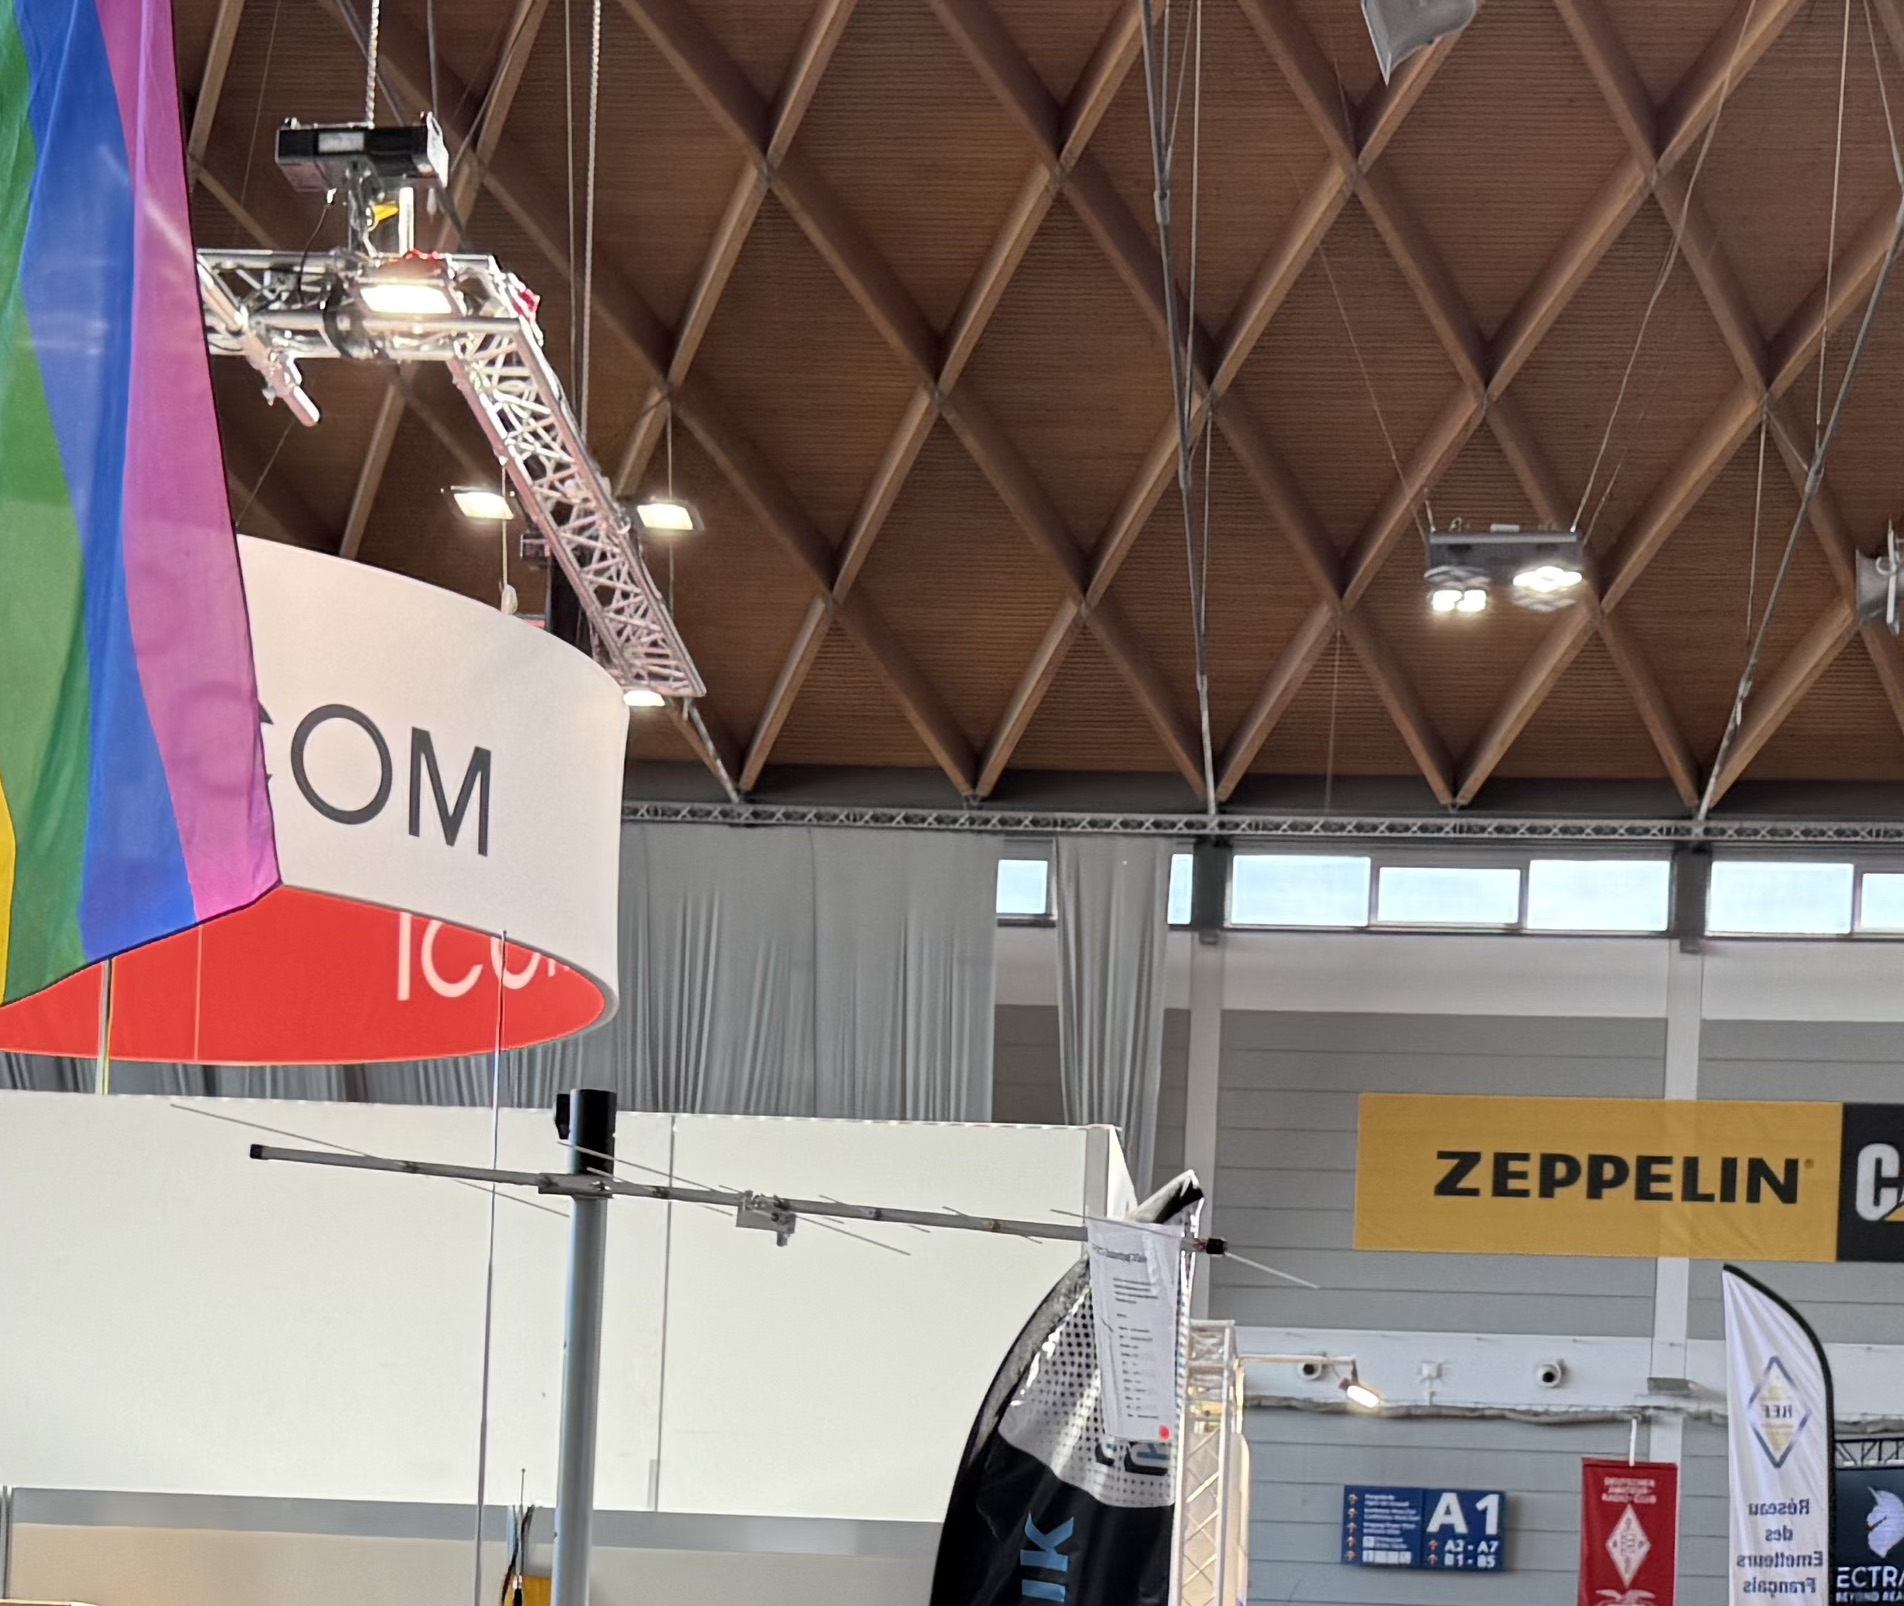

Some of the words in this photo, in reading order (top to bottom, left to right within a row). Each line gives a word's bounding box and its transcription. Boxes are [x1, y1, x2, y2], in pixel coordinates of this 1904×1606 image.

[259, 700, 491, 857] OM
[398, 912, 570, 1001] ICO
[1433, 1150, 1801, 1205] ZEPPELIN
